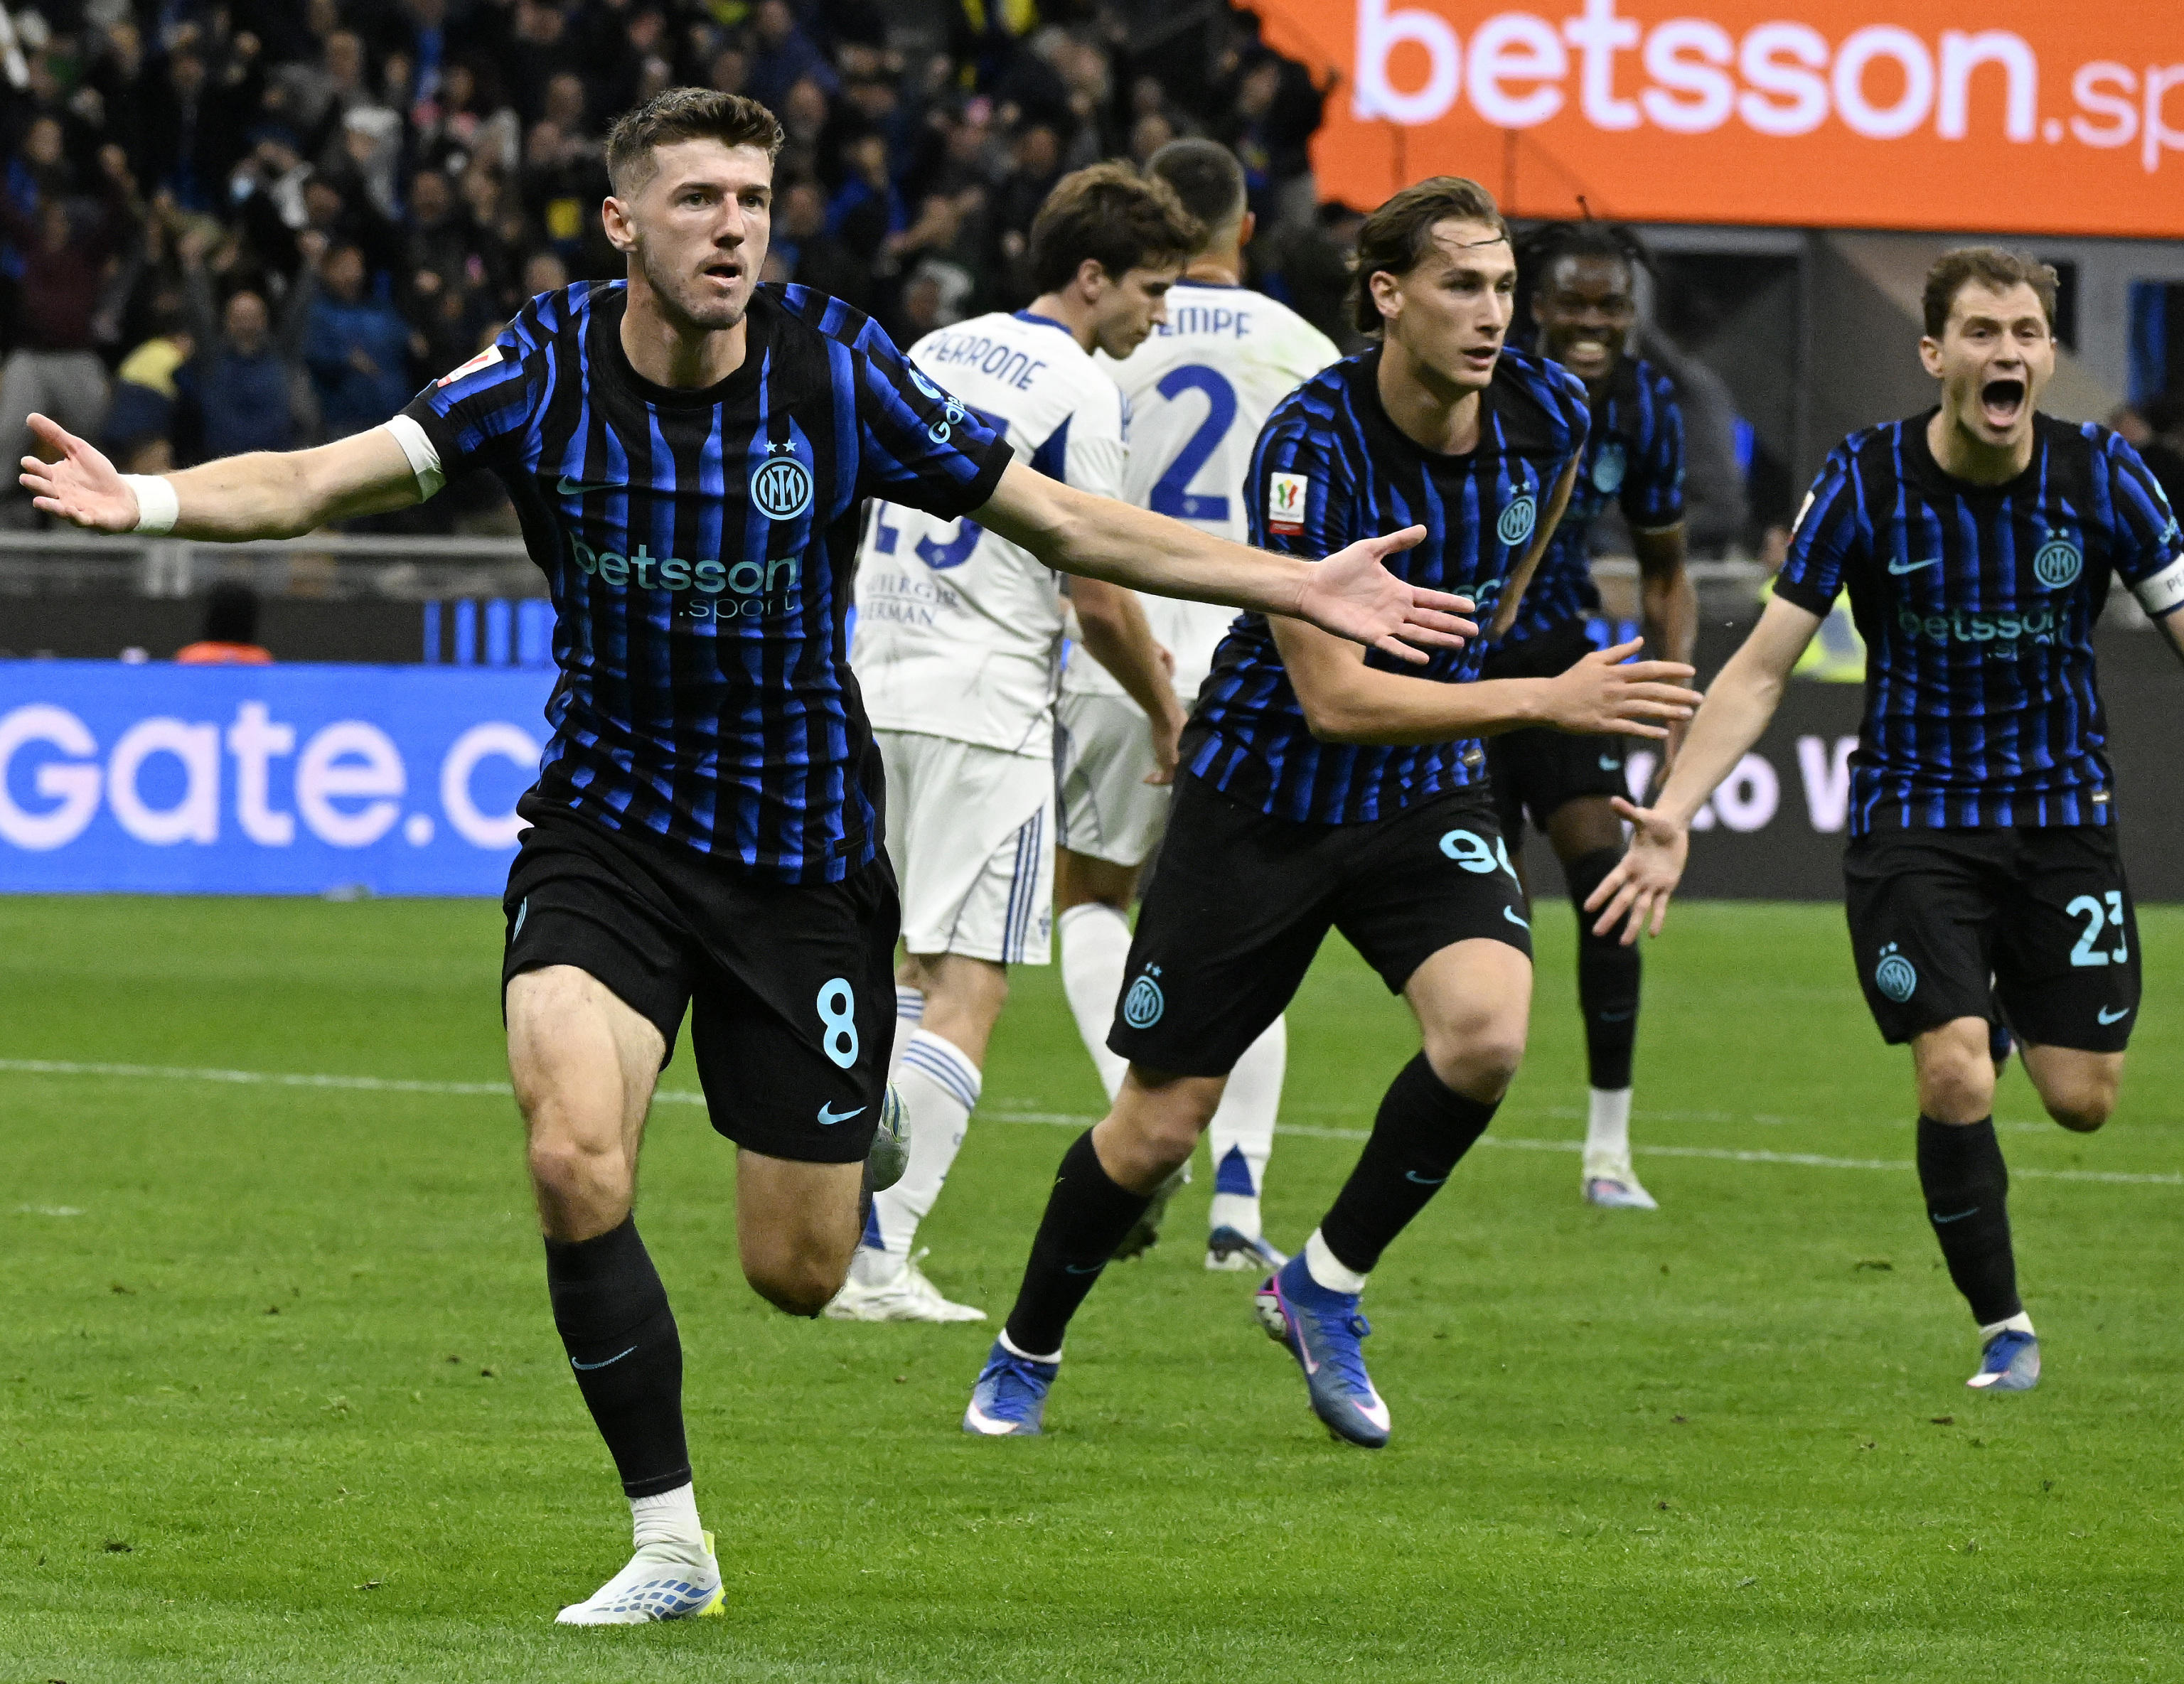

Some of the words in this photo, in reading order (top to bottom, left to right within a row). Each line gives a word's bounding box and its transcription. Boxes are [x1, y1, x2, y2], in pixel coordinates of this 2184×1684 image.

[922, 332, 1048, 390] PERRONE
[1149, 364, 1239, 521] 2
[569, 532, 798, 594] betsson
[678, 589, 796, 624] .sport
[816, 977, 860, 1069] 8
